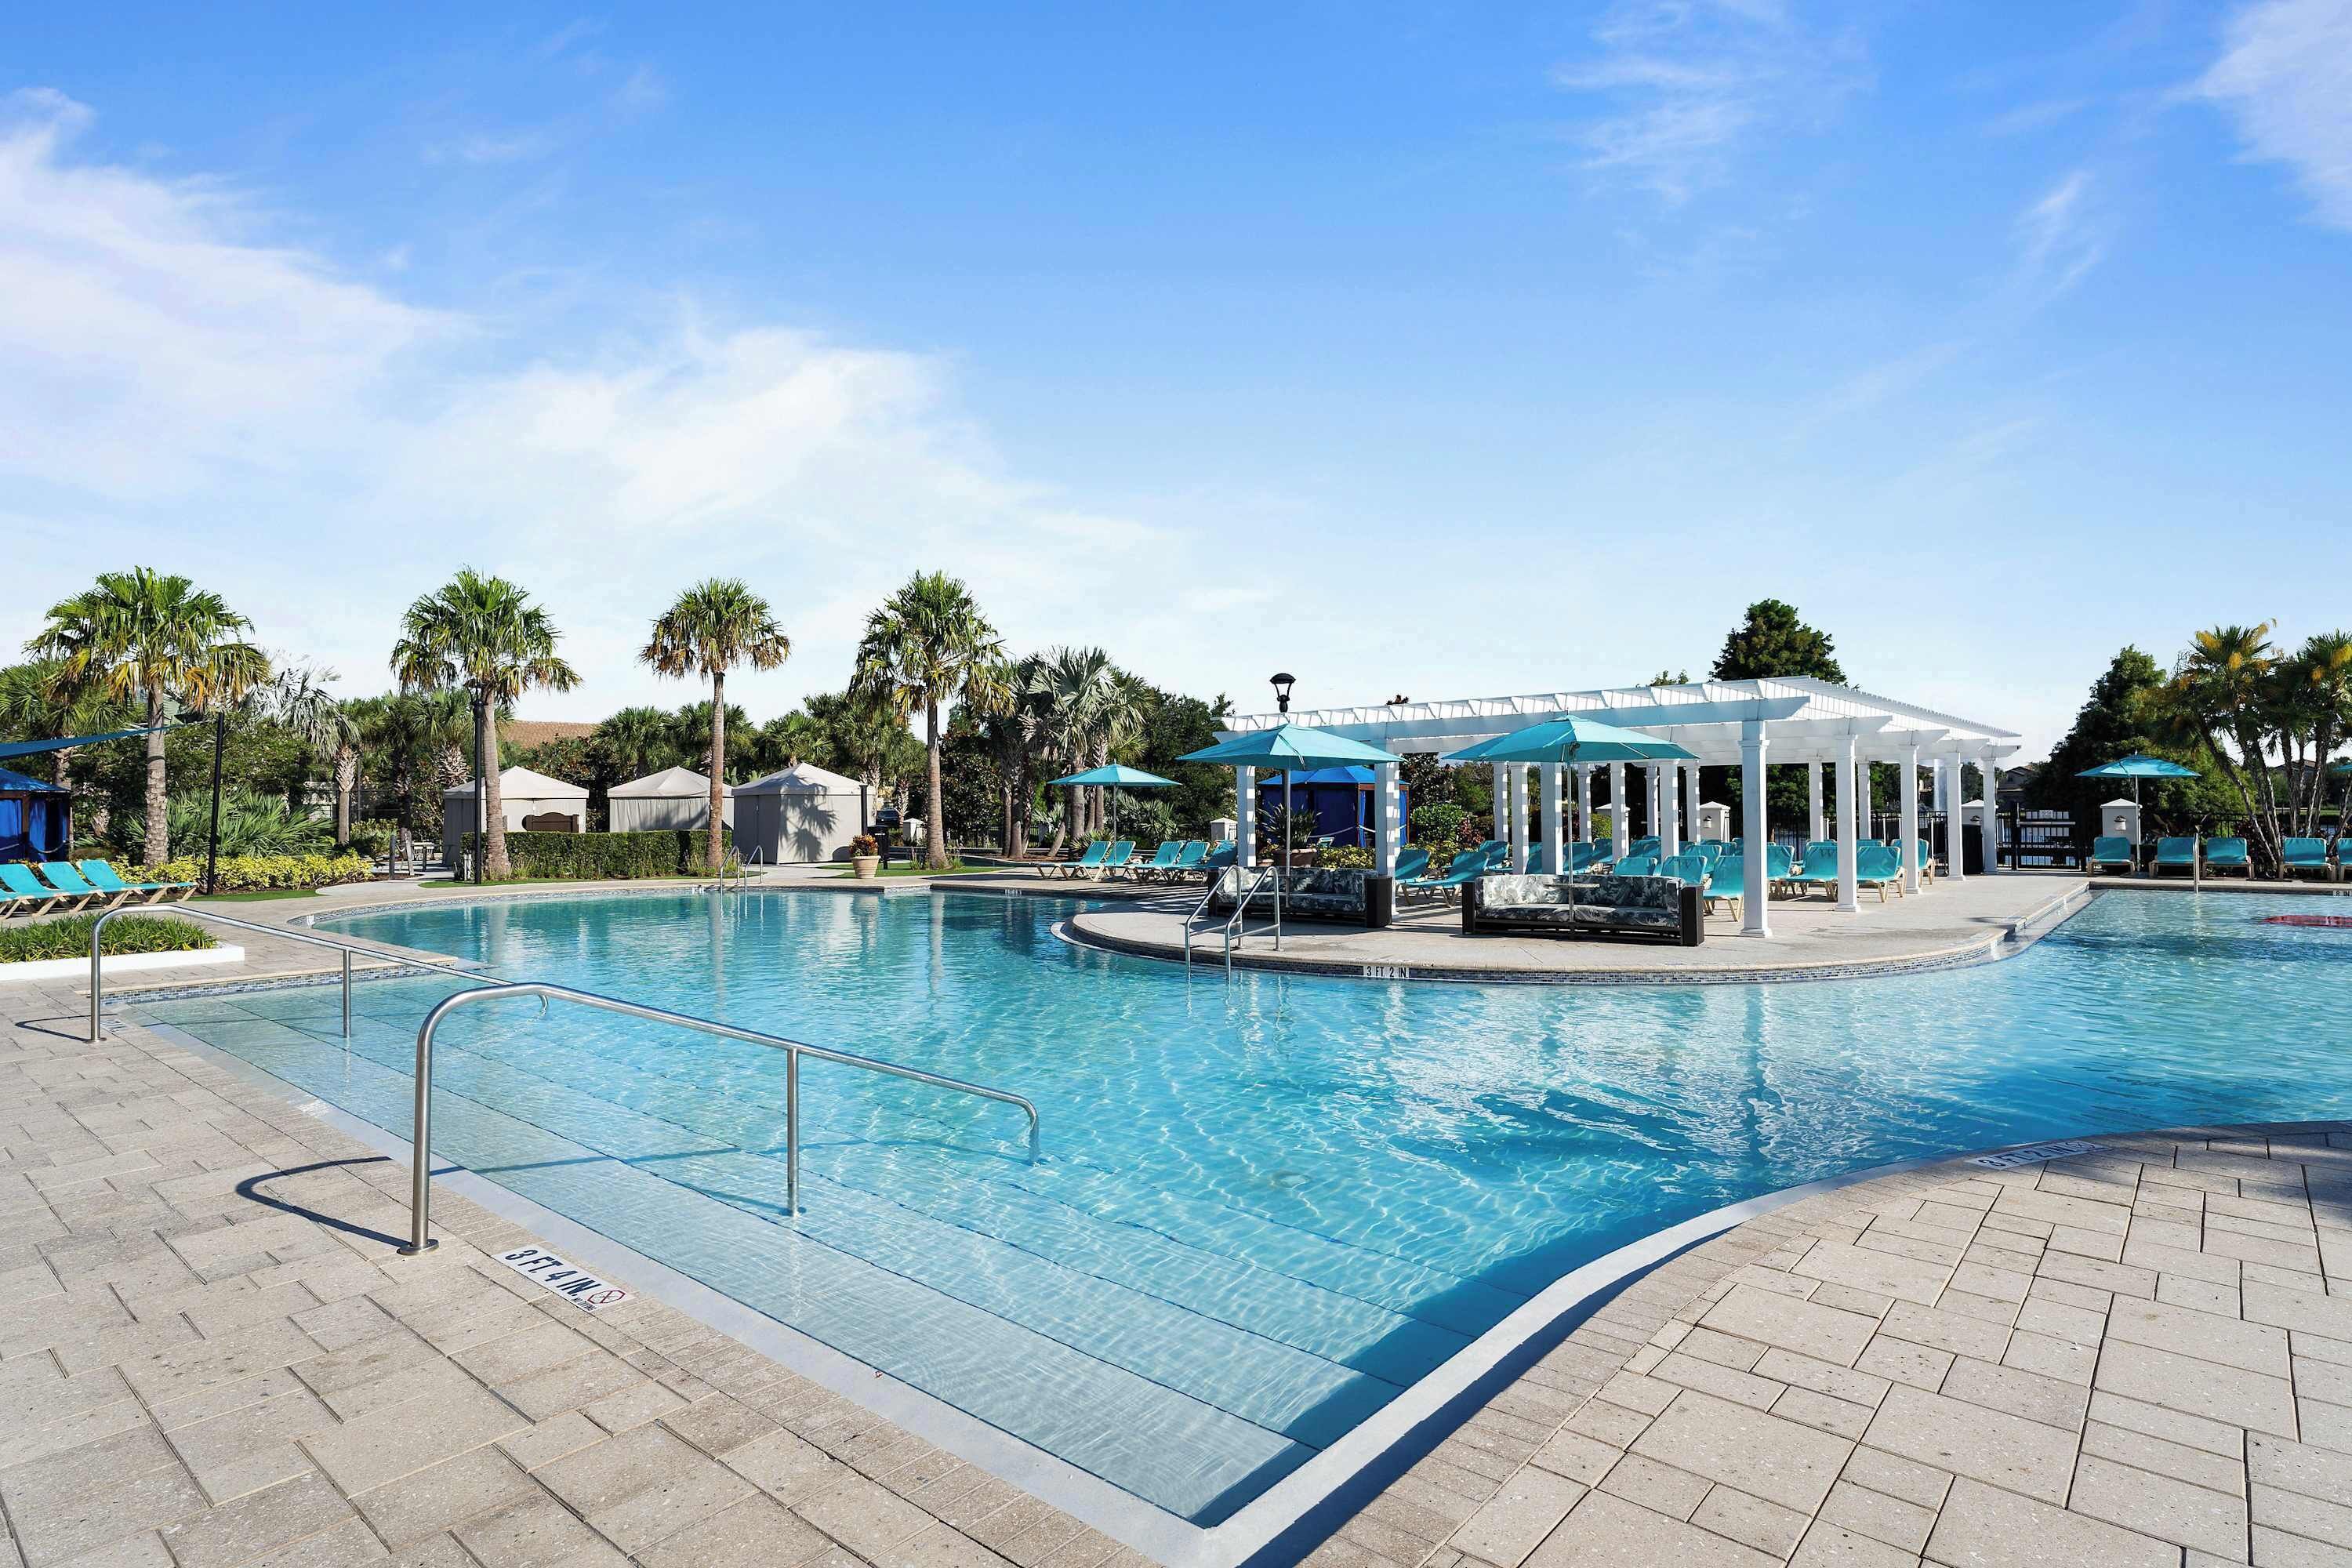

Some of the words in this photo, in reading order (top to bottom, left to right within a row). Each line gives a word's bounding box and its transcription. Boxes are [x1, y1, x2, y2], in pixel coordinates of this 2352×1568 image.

[1367, 966, 1372, 976] 3
[1389, 967, 1394, 977] 2
[505, 1249, 538, 1261] 3
[517, 1256, 564, 1273] FT.
[544, 1270, 578, 1282] 4
[556, 1277, 601, 1297] IN.
